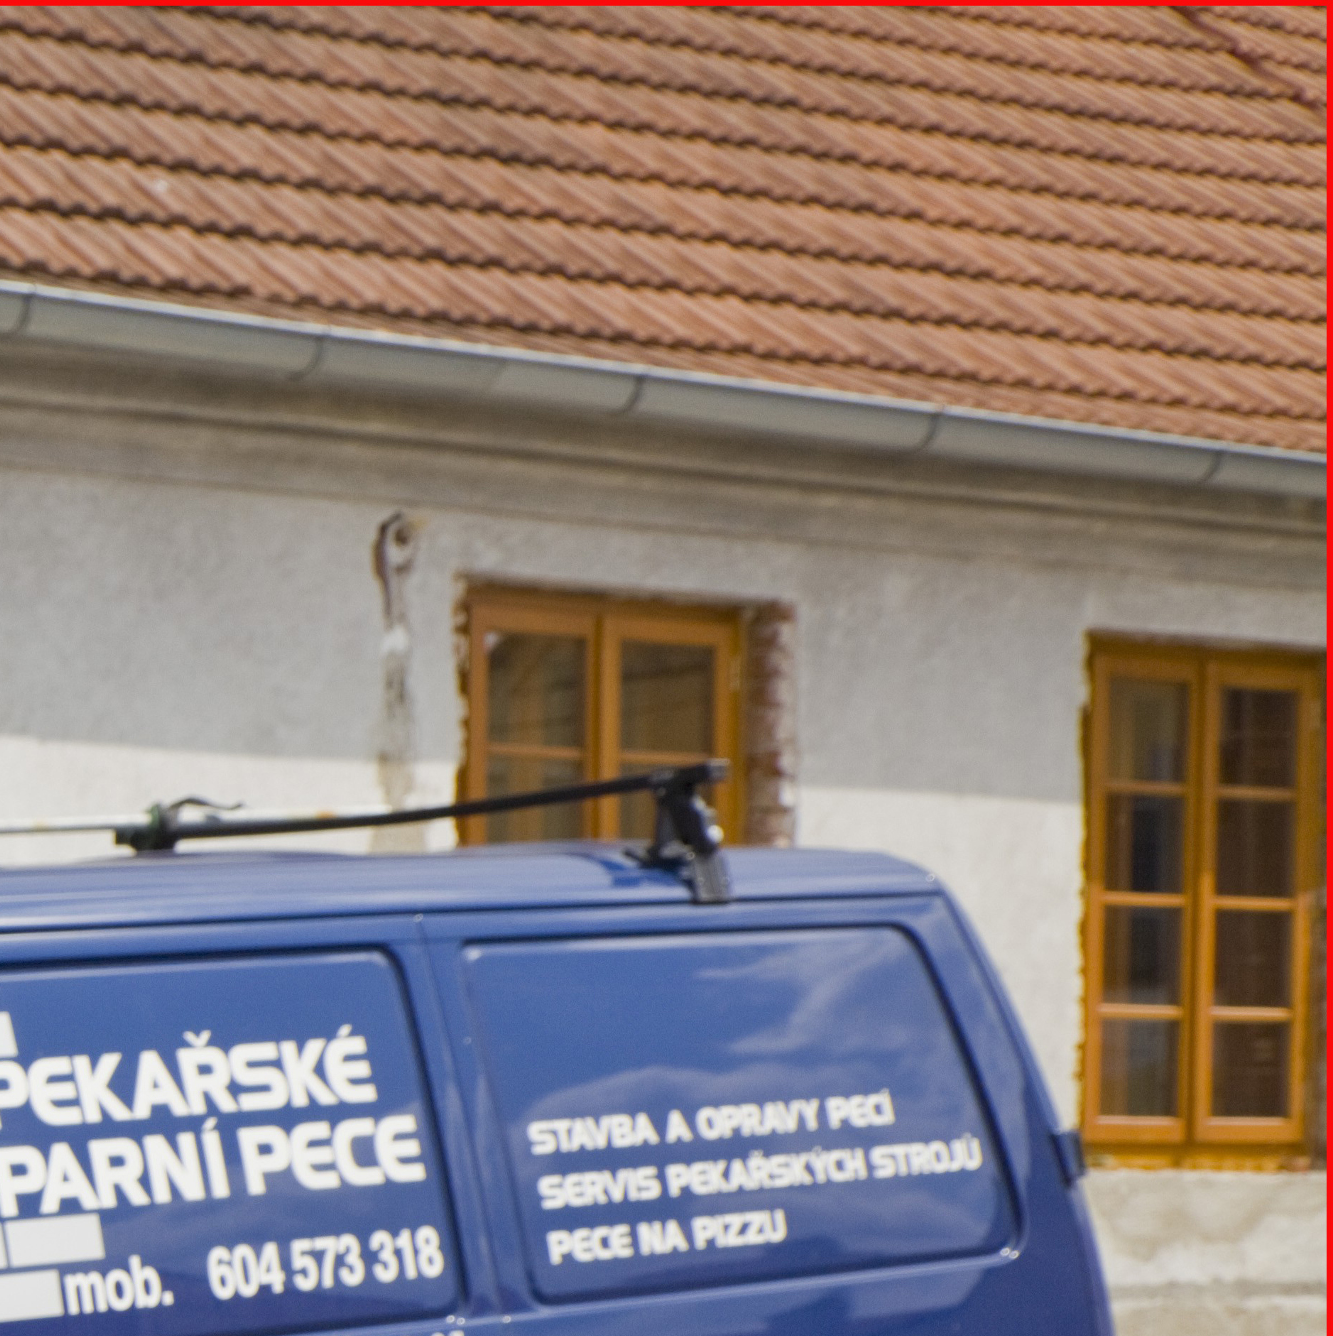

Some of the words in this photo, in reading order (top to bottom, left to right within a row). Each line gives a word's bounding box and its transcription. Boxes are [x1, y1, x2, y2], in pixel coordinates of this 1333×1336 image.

[236, 1113, 427, 1196] PECE
[526, 1112, 660, 1155] STAVBA
[666, 1108, 694, 1144] A
[696, 1097, 820, 1140] OPRAVY
[824, 1087, 896, 1130] PECÍ
[537, 1165, 662, 1210] SERVIS
[665, 1146, 869, 1199] PEKAŘSKÝCH
[869, 1131, 983, 1179] STROJŮ
[66, 1256, 175, 1316] mob.
[207, 1241, 286, 1300] 604
[291, 1233, 366, 1293] 573
[370, 1225, 445, 1284] 318
[546, 1223, 635, 1266] PECE
[637, 1219, 690, 1256] NA
[691, 1208, 787, 1251] PIZZU
